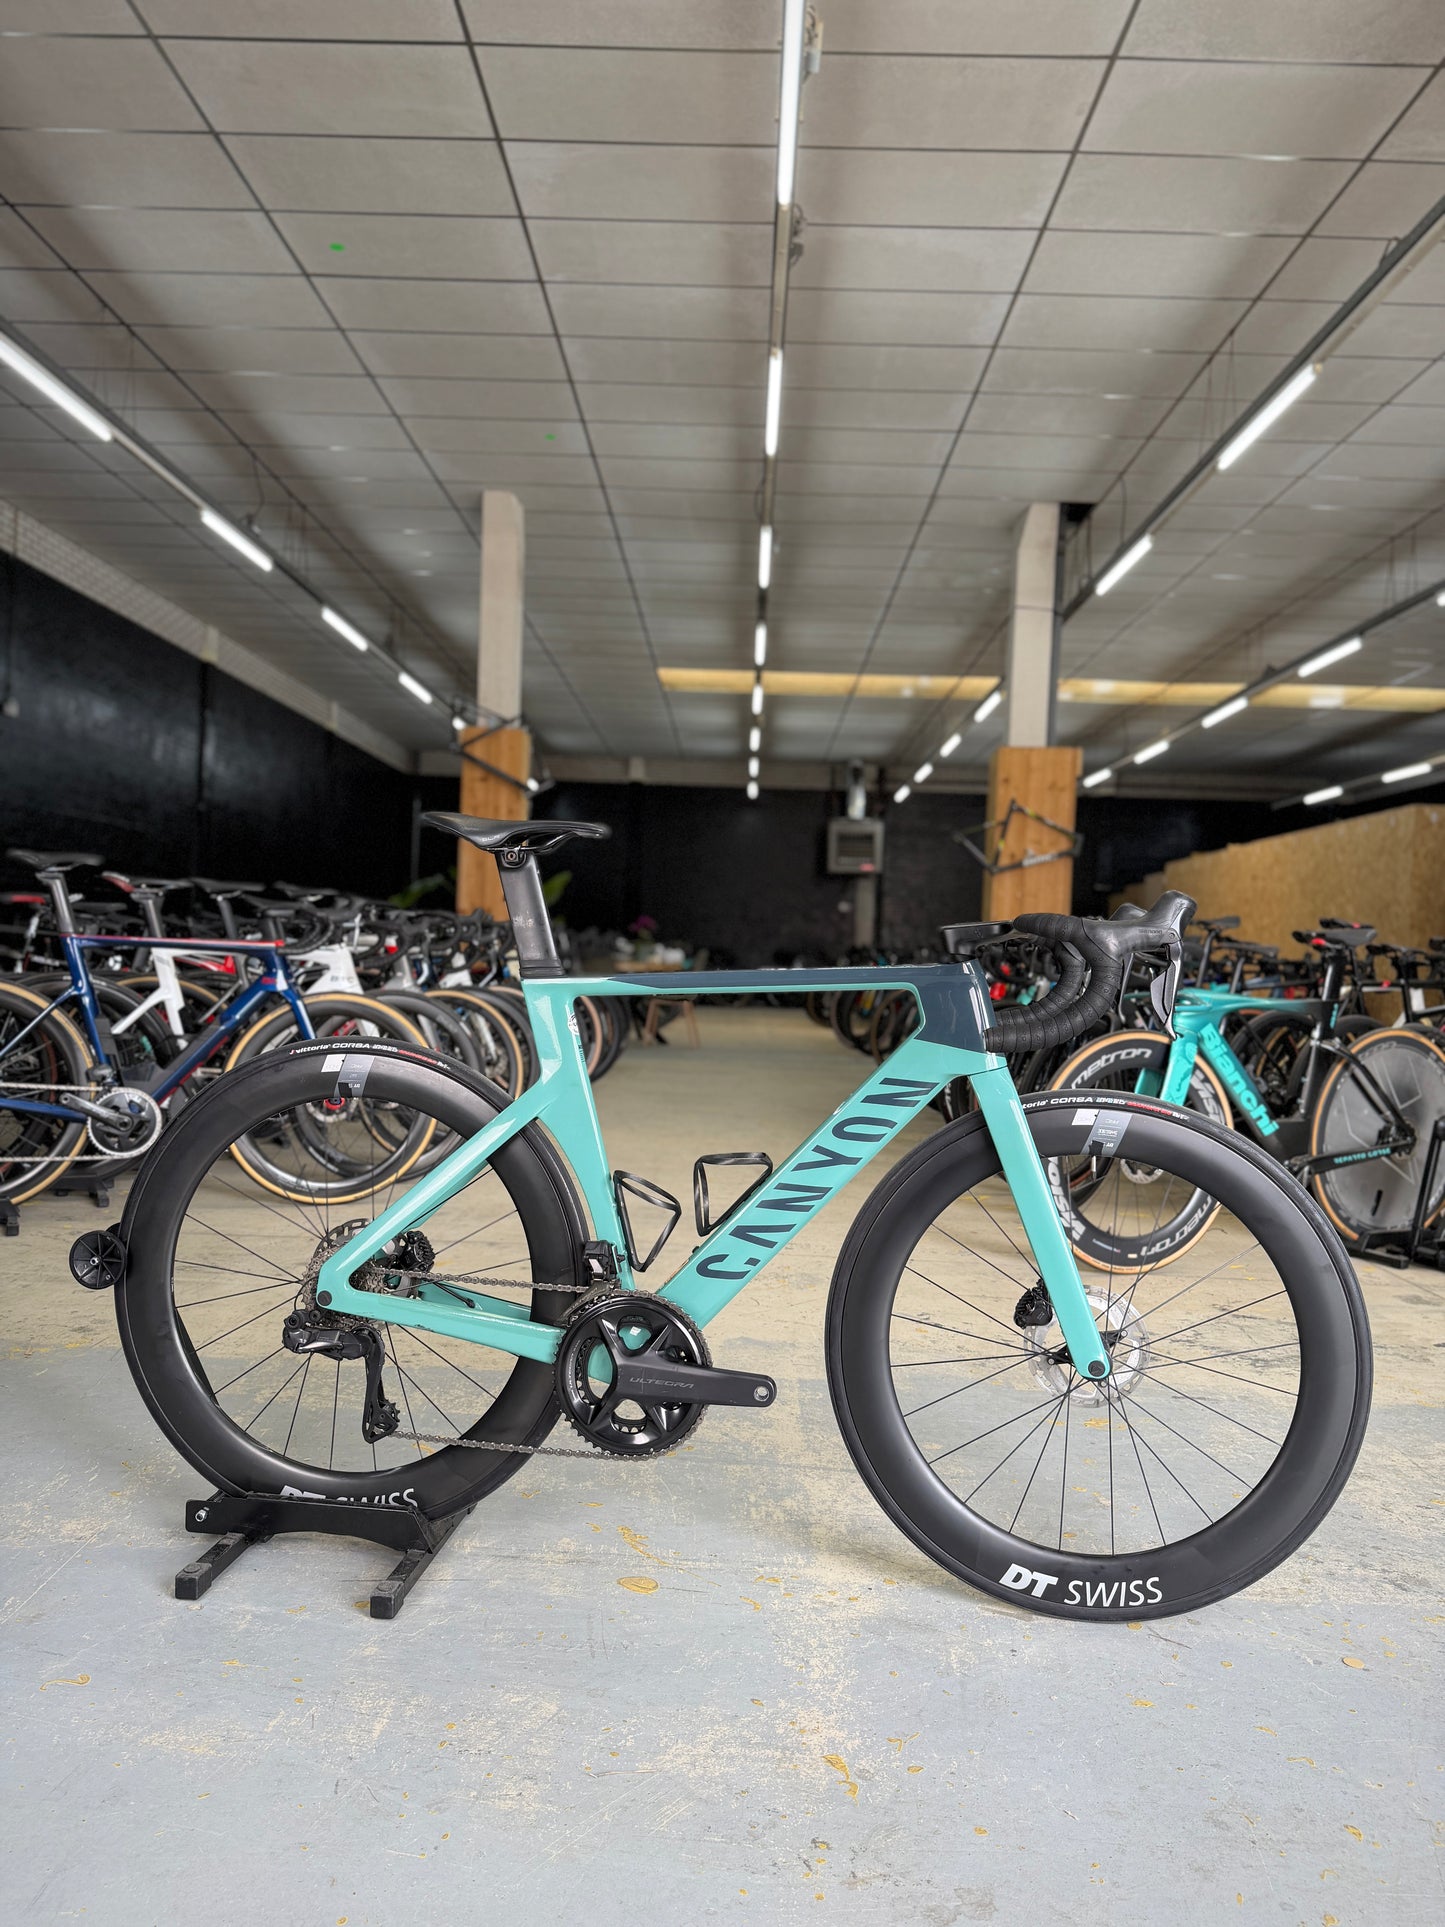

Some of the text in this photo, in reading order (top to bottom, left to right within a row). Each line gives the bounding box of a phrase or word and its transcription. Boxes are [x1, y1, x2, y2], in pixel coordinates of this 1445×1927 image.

[1070, 1047, 1152, 1090] metron
[1199, 1022, 1280, 1137] Bianchi
[1050, 1096, 1094, 1105] CORSA
[695, 1077, 941, 1280] CANYON
[629, 1376, 695, 1389] ULTEGRA
[998, 1562, 1164, 1608] DT SWISS
